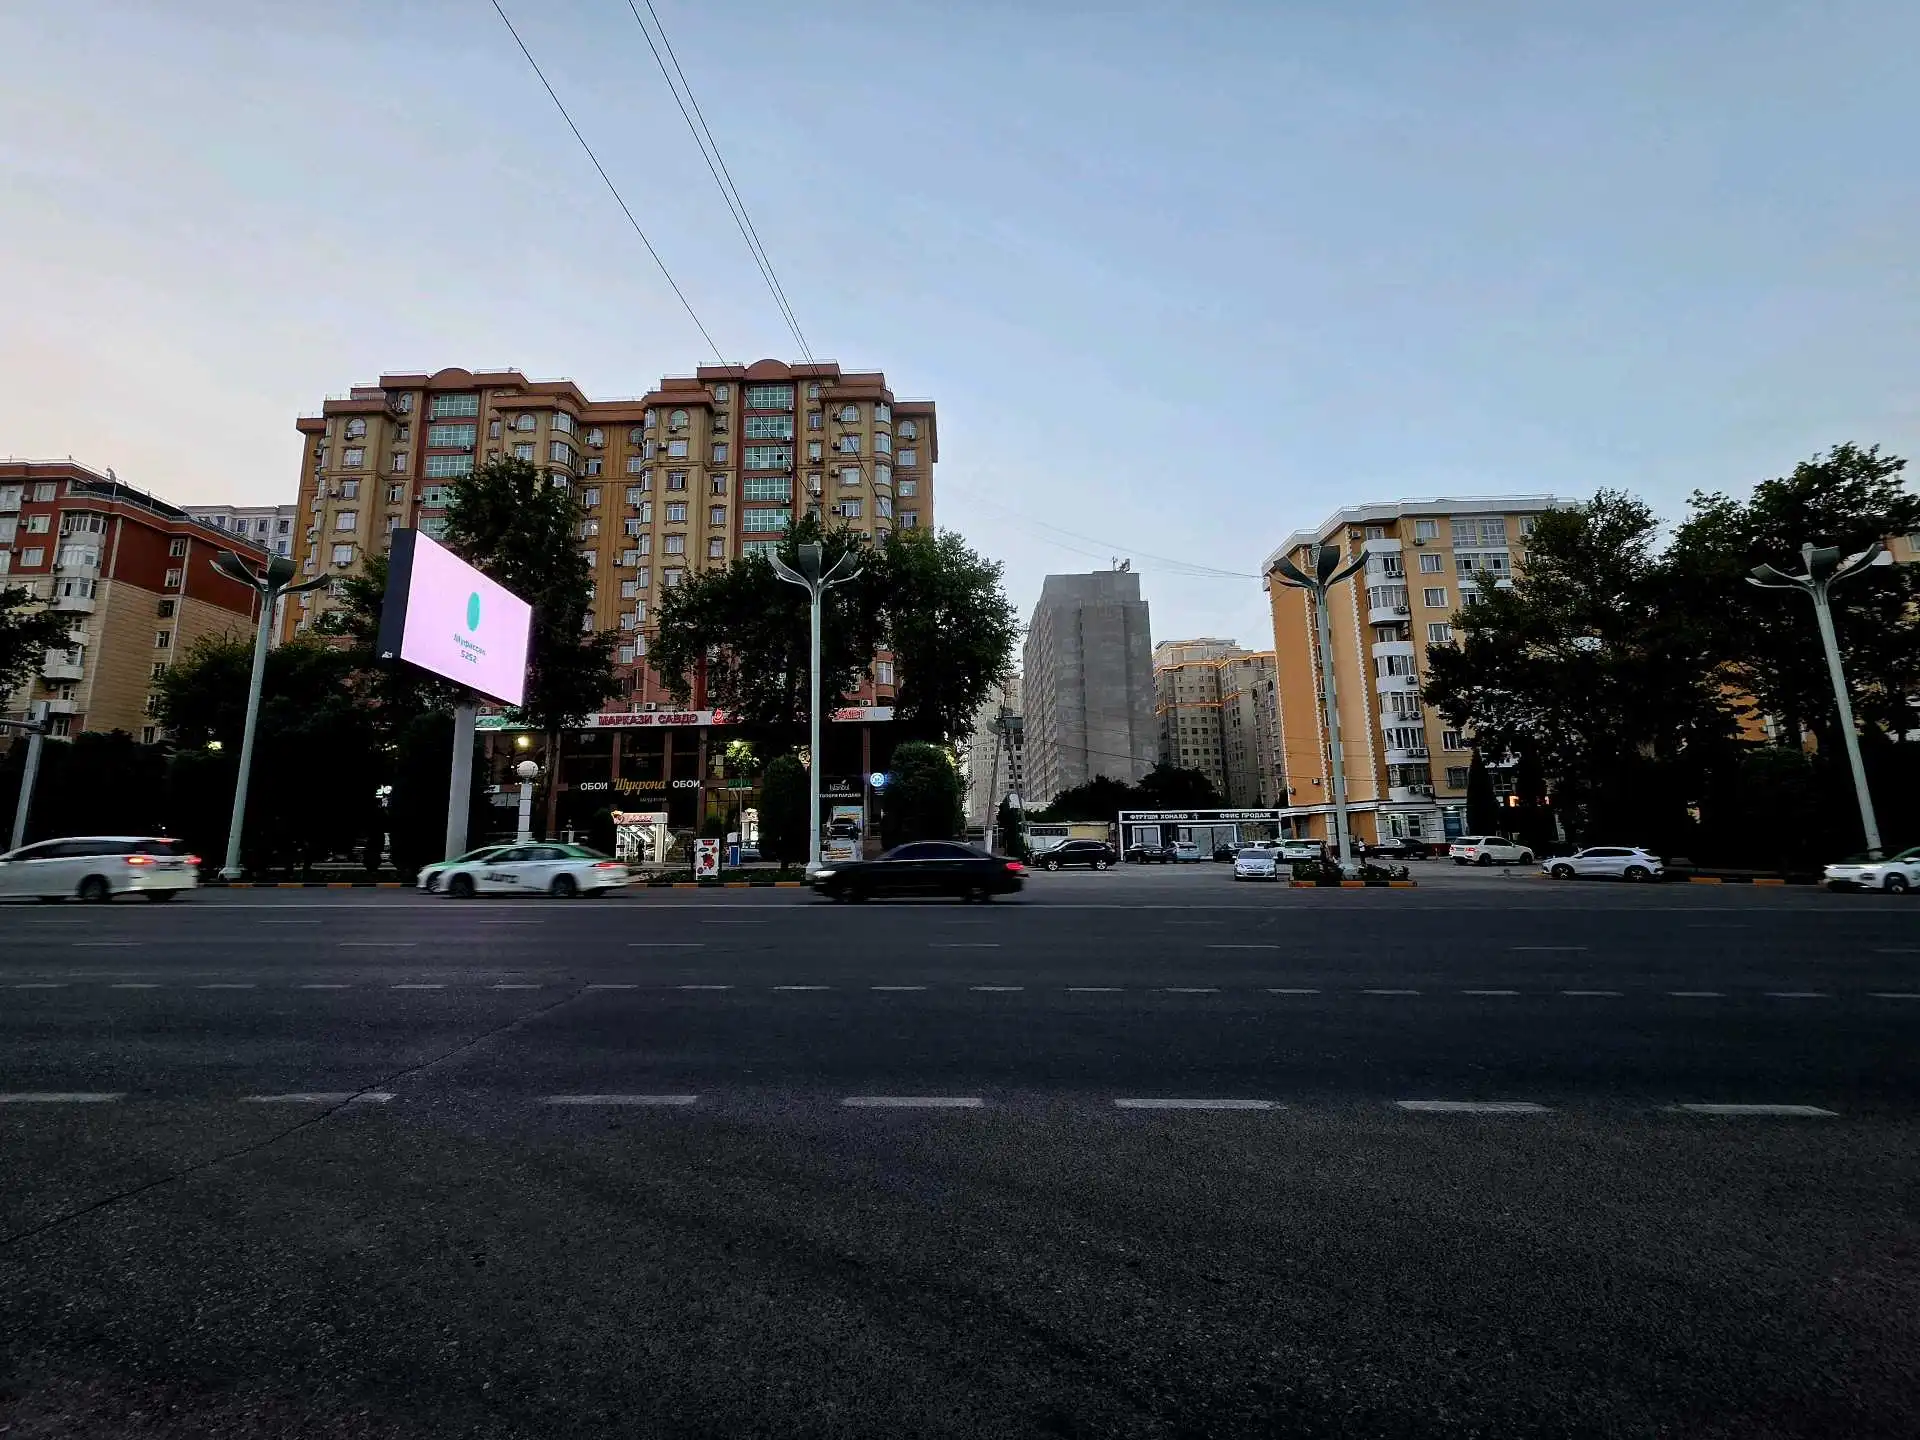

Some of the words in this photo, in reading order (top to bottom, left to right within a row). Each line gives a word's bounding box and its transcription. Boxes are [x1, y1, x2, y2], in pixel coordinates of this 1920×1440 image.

[460, 650, 477, 664] 5252
[599, 715, 652, 726] МАРКАЗИ
[658, 713, 698, 725] САВДО
[580, 782, 608, 791] ОБОИ
[615, 778, 667, 795] Шукрона
[672, 780, 700, 788] ОБОИ
